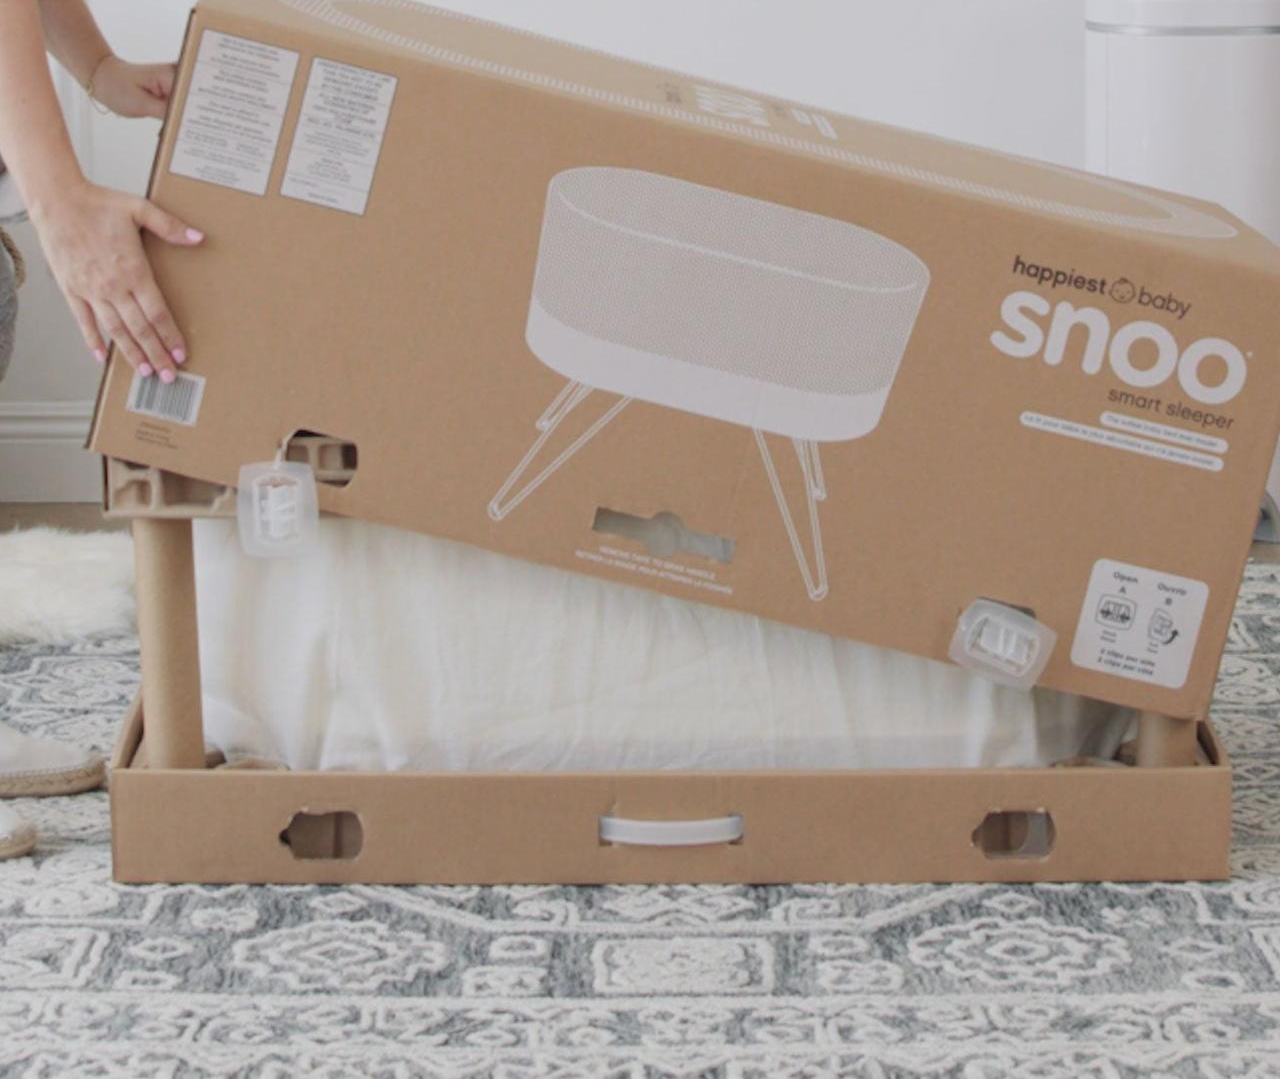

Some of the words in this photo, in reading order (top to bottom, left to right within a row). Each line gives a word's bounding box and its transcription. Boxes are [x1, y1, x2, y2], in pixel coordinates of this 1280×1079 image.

[1012, 255, 1108, 295] happiest
[1137, 287, 1192, 320] baby
[990, 290, 1248, 405] snoo
[1107, 387, 1162, 413] smart
[1165, 402, 1235, 430] sleeper
[1113, 571, 1138, 584] Open
[1118, 586, 1126, 595] A
